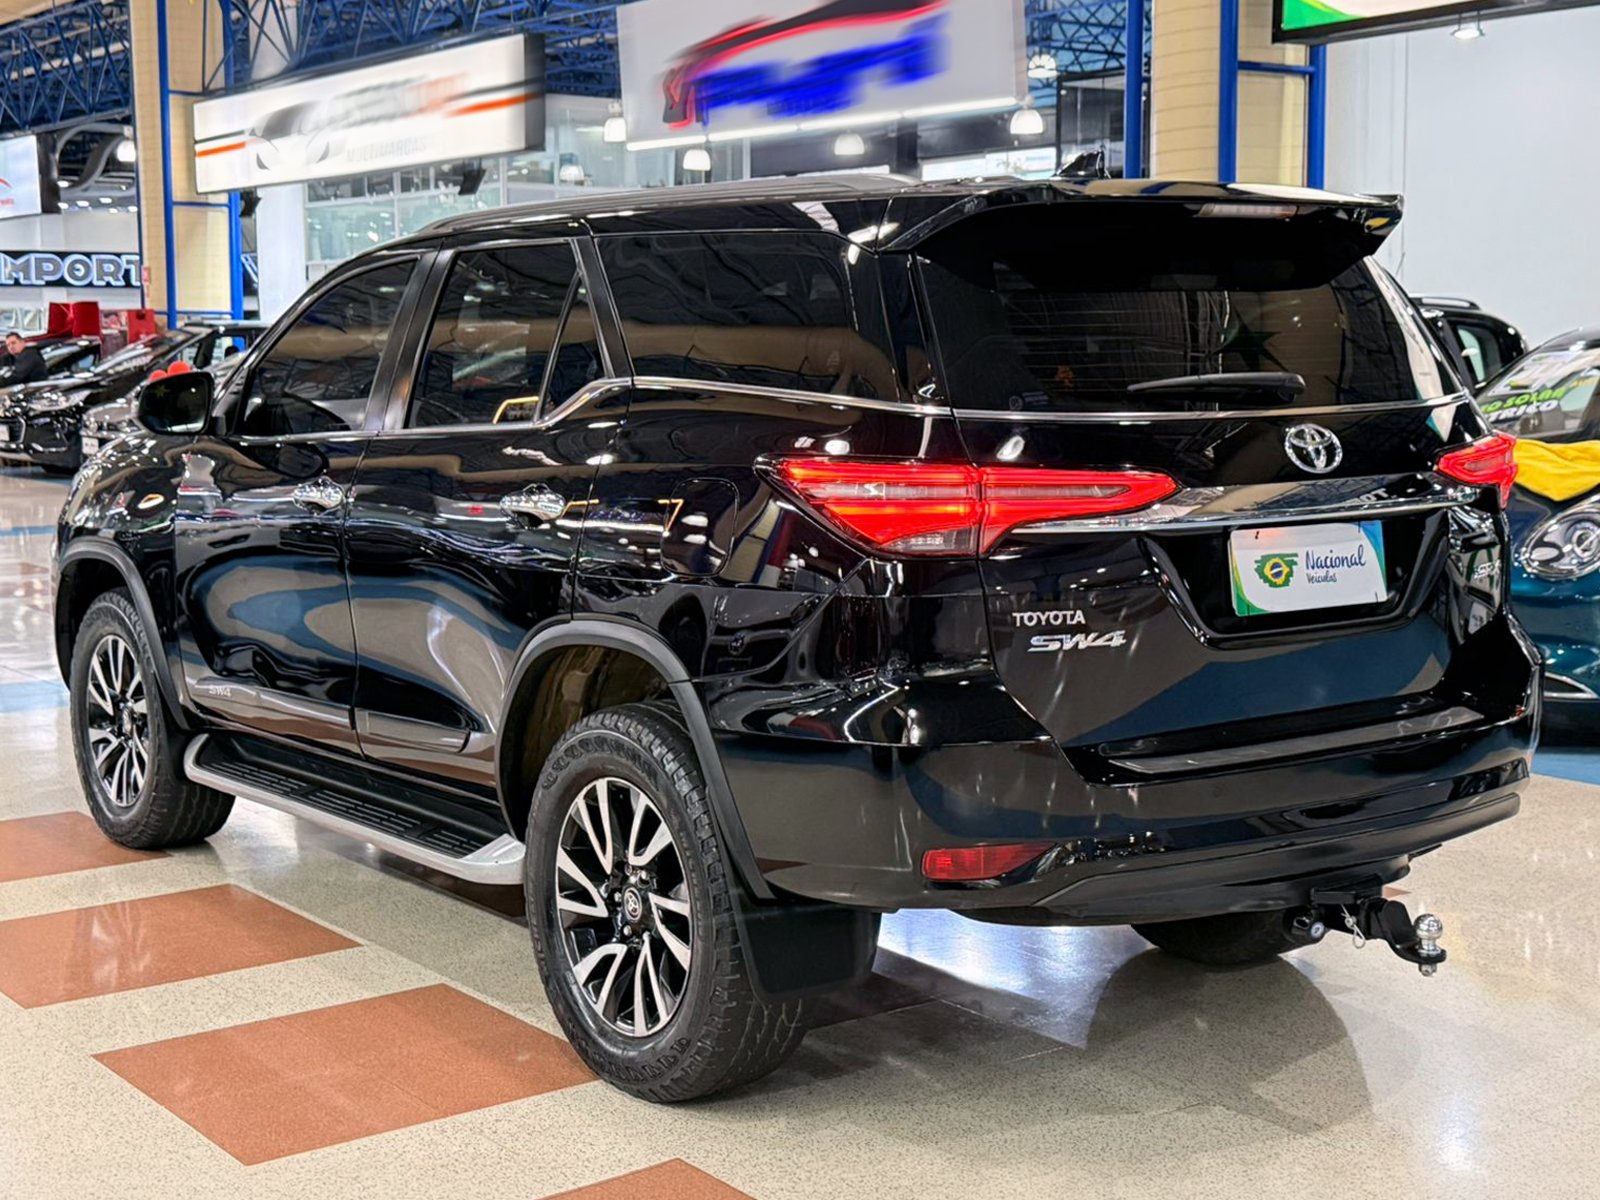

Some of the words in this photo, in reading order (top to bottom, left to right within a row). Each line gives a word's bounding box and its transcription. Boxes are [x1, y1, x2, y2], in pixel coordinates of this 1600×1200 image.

[1305, 544, 1367, 571] Nacional
[1012, 609, 1086, 627] TOYOTA
[1027, 629, 1127, 652] SW4
